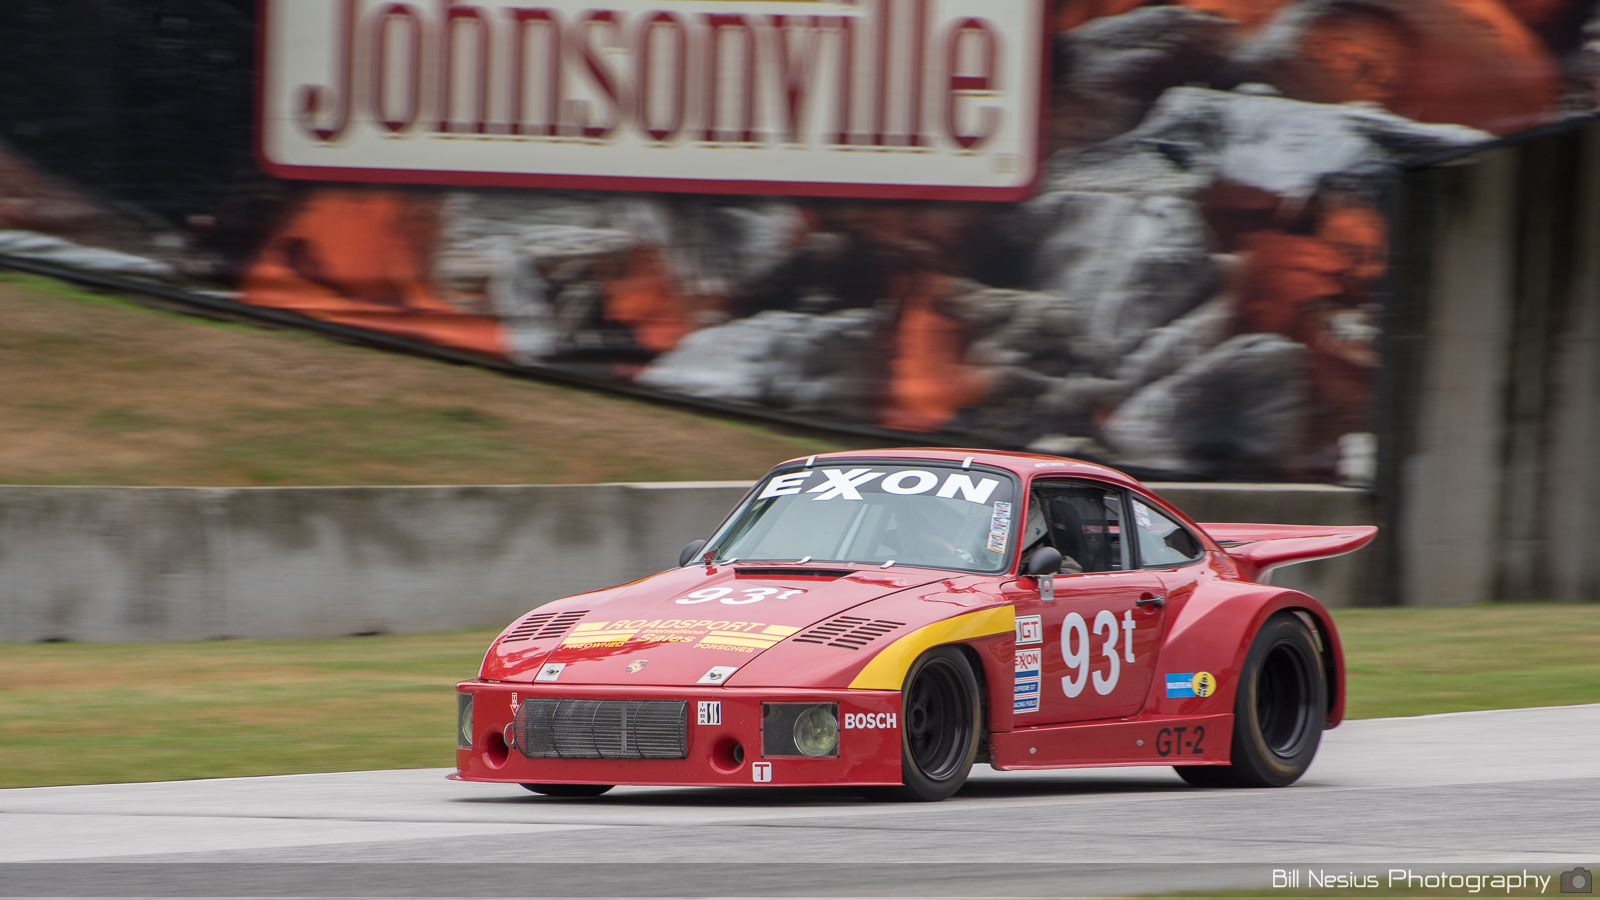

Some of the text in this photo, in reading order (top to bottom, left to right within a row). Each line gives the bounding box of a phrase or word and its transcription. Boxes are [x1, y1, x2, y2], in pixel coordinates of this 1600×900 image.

[294, 0, 1003, 153] Johnsonville
[757, 468, 999, 504] EXXON
[606, 619, 766, 632] ROADSPORT
[642, 628, 709, 636] International
[1022, 621, 1039, 639] GT
[563, 641, 625, 650] PREOWNED
[636, 633, 697, 643] Sales
[693, 643, 755, 653] PORSCHES
[1060, 609, 1136, 698] 93t
[844, 712, 898, 730] BOSCH
[1156, 725, 1205, 757] GT-2
[754, 763, 771, 781] T
